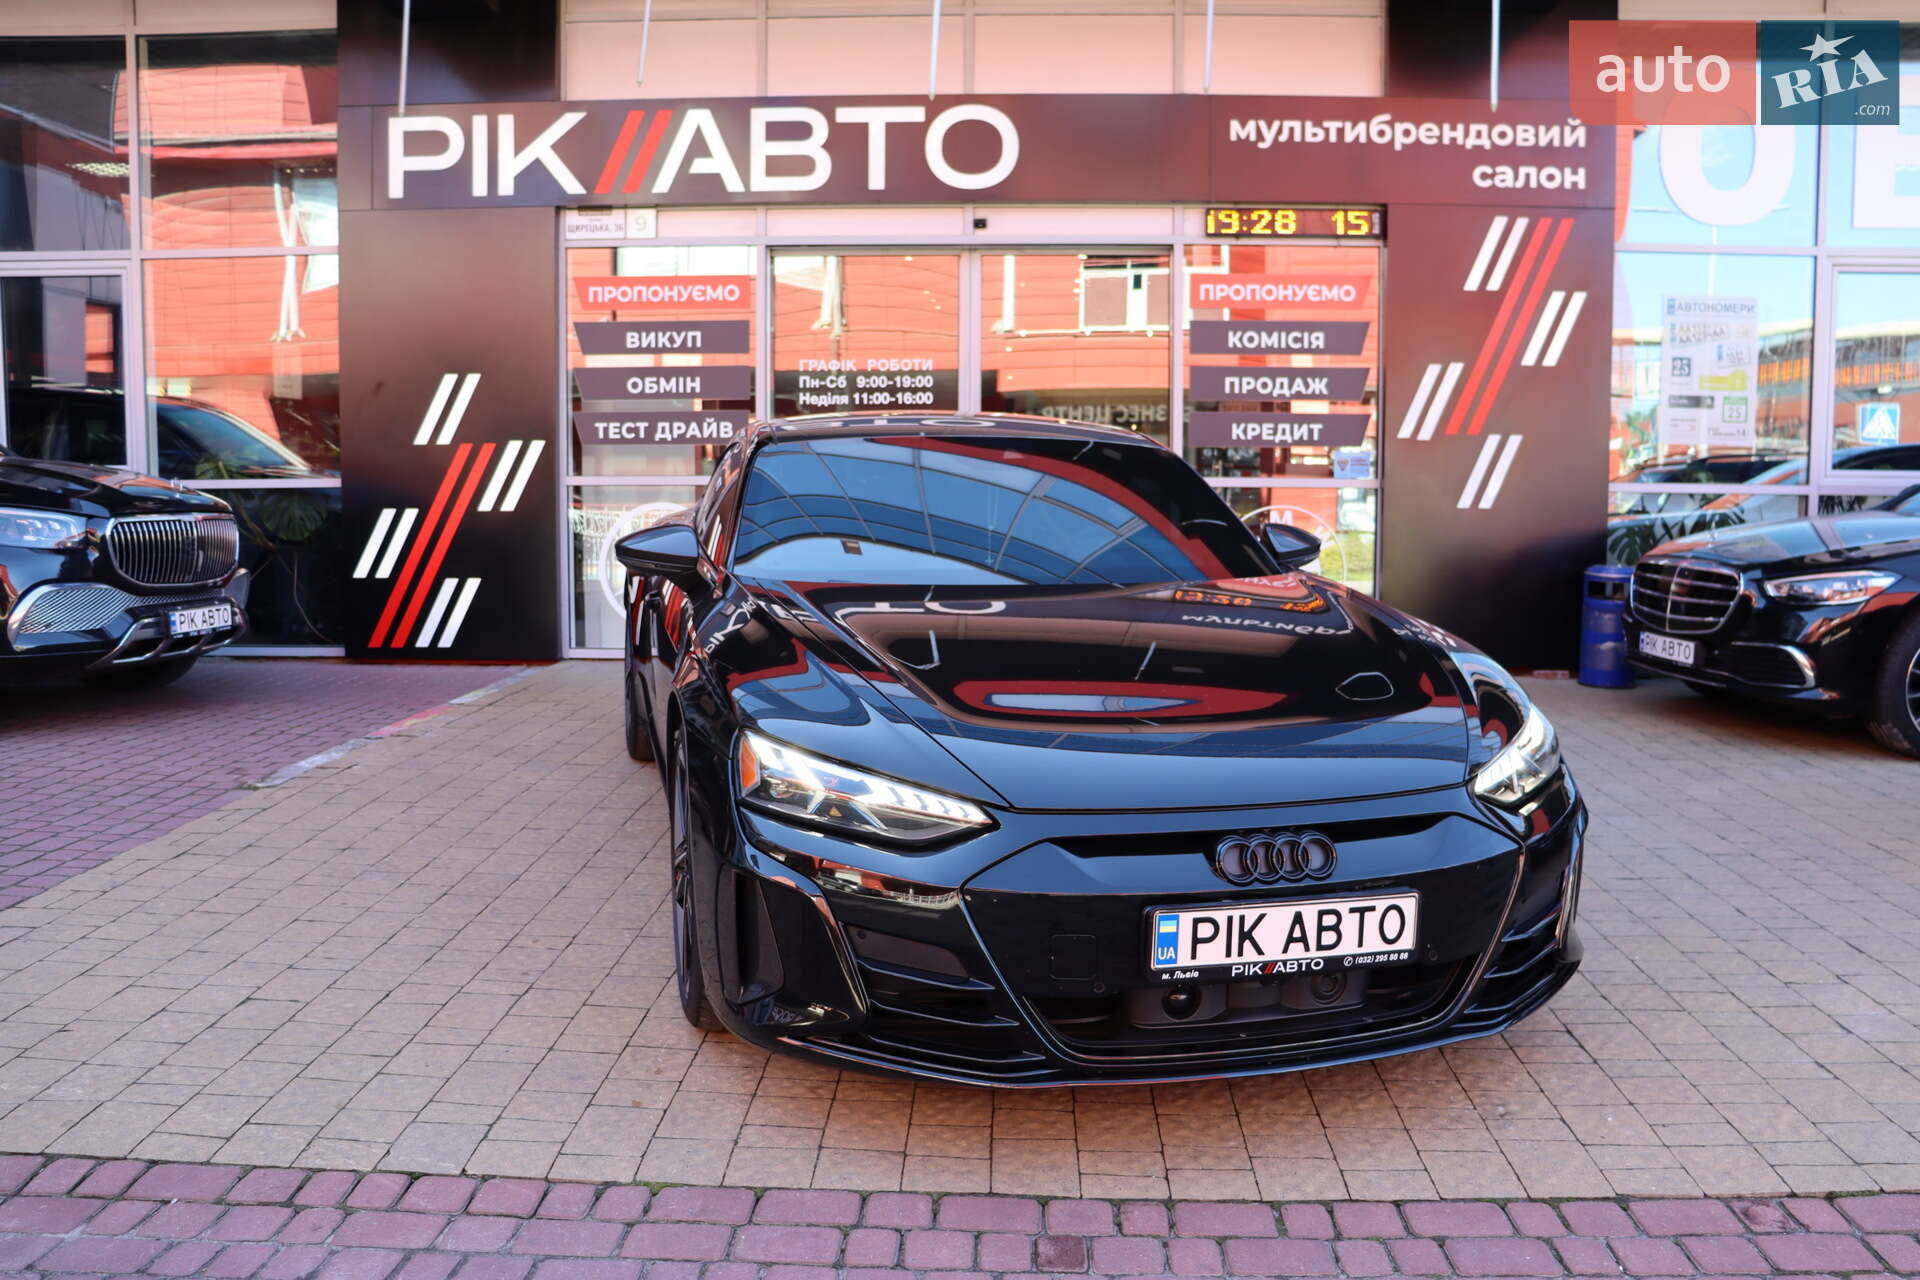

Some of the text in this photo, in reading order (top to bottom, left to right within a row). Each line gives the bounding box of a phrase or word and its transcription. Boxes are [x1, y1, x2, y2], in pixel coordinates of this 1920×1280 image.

[1228, 113, 1587, 152] мультибрендовий
[1471, 163, 1587, 190] салон
[634, 215, 648, 232] 9
[1331, 210, 1371, 236] 15
[588, 284, 741, 303] ПРОПОНУЄМО
[1199, 284, 1357, 303] ПРОПОНУЄМО
[625, 330, 702, 349] ВИКУП
[1227, 330, 1325, 350] КОМІСІЯ
[799, 359, 934, 372] ГРАФІК РОБОТИ
[626, 376, 701, 394] ОБМІН
[799, 375, 934, 389] Пн-Сб 9:00-19:00
[1224, 376, 1328, 396] ПРОДАЖ
[799, 392, 934, 407] Неділя 11:00-16:00
[594, 417, 733, 441] ТЕСТ ДРАЙВ
[1231, 423, 1323, 443] КРЕДИТ
[1190, 903, 1406, 960] РІК АВТО
[1158, 947, 1176, 960] UA
